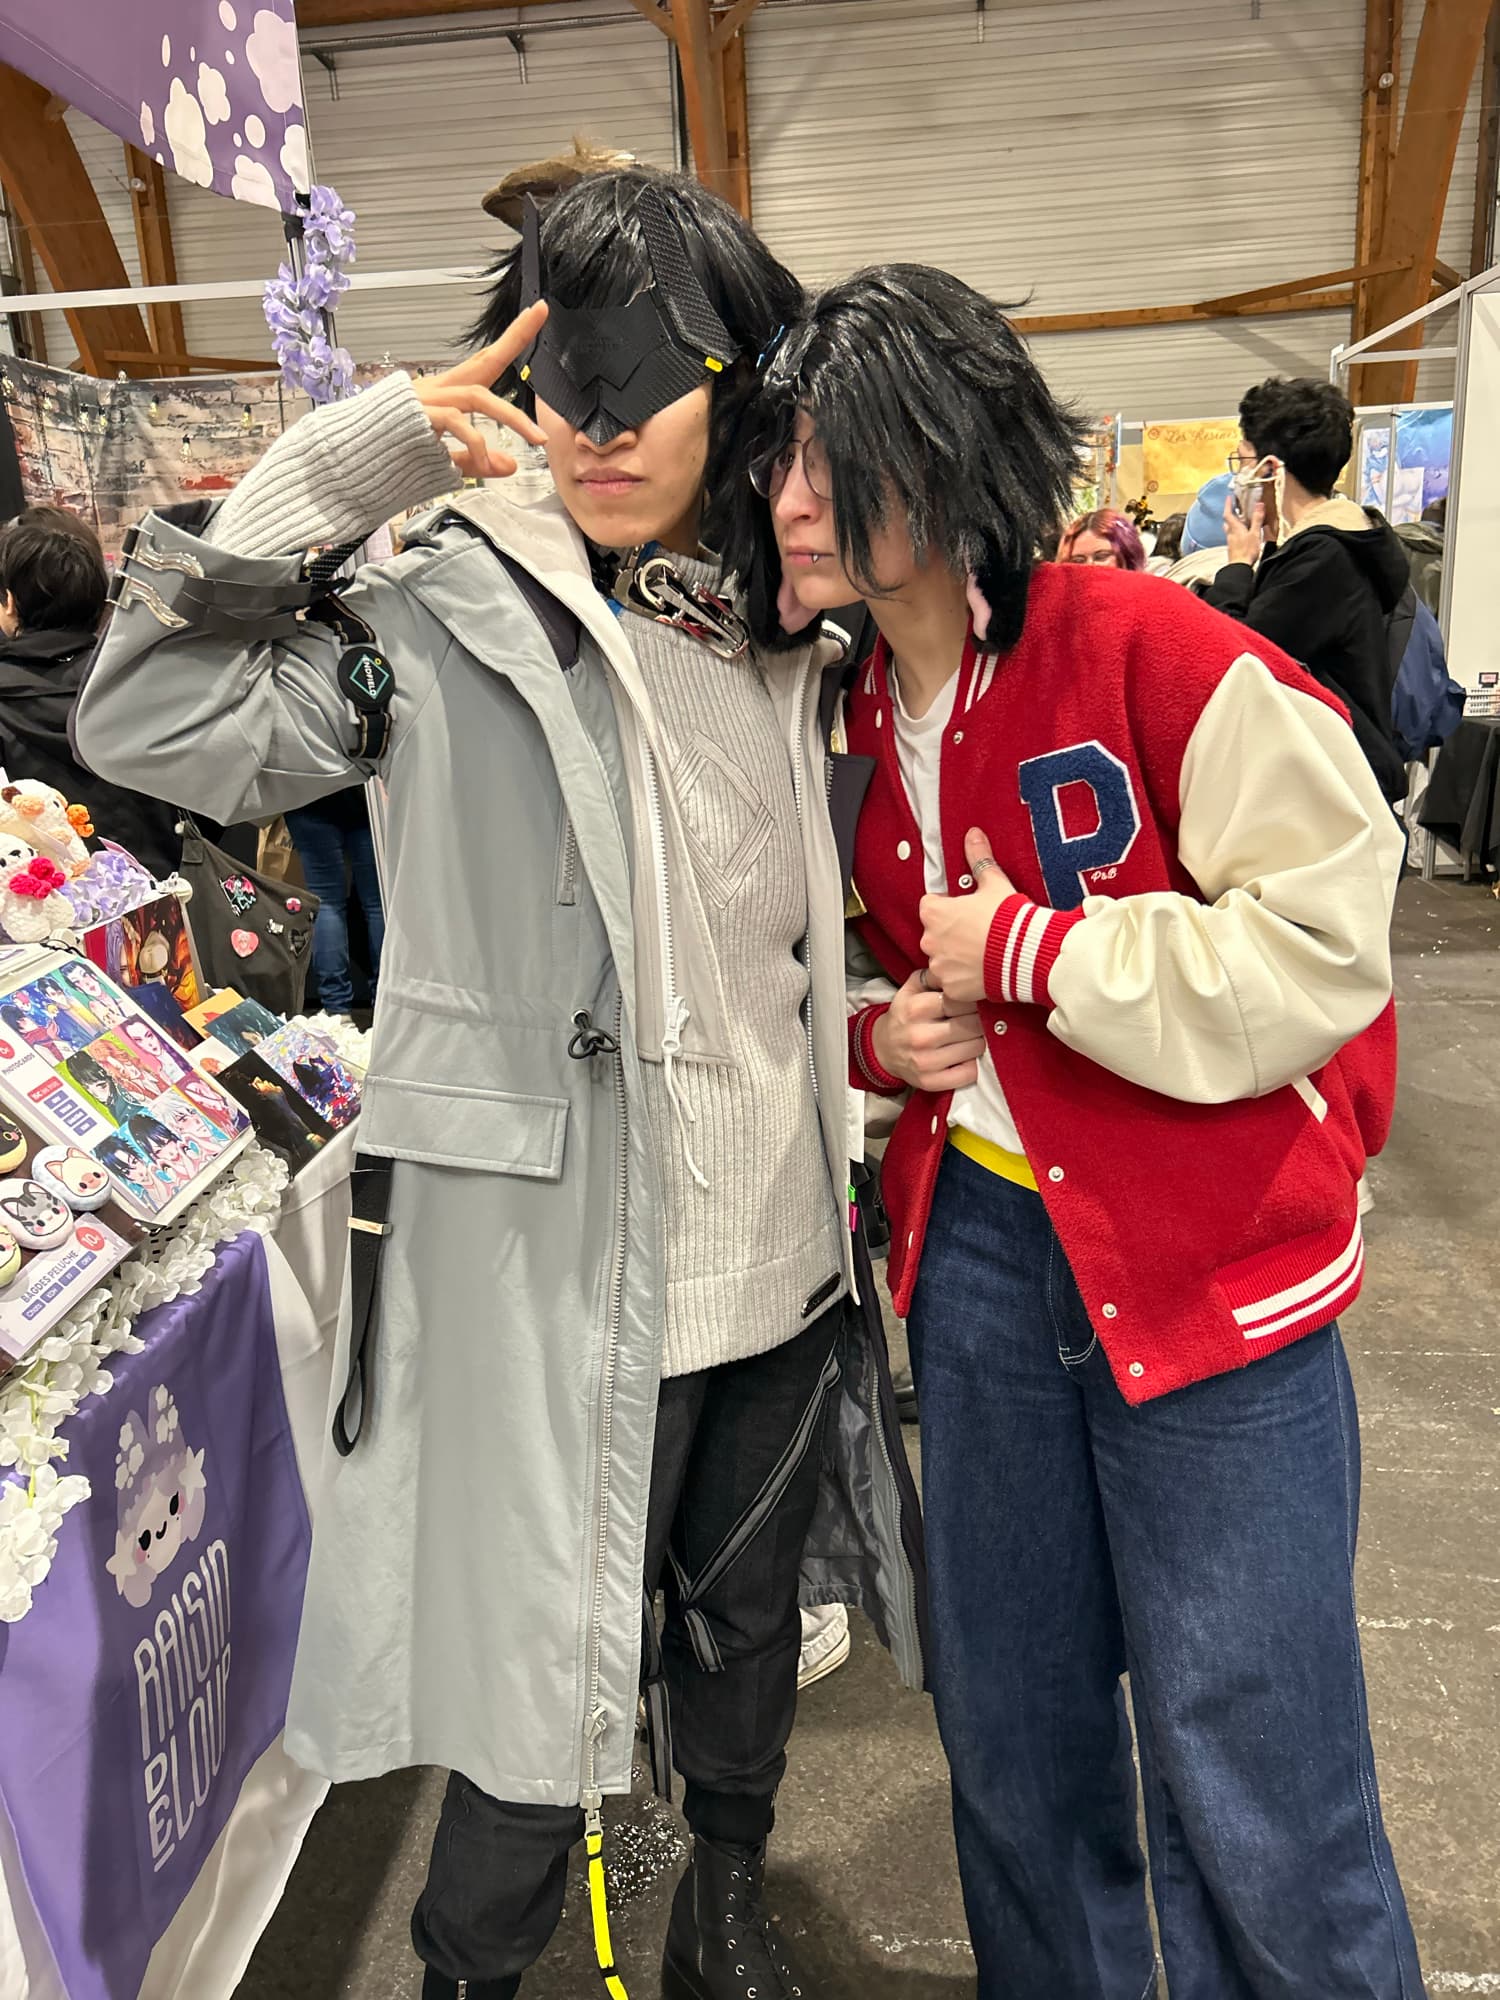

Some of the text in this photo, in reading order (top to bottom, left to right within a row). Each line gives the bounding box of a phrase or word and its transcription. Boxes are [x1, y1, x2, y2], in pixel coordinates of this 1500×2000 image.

[1018, 739, 1142, 912] P
[20, 1250, 79, 1303] BAGDES PELUCHE
[133, 1538, 232, 1761] RAISIN
[169, 1642, 232, 1841] LOUP
